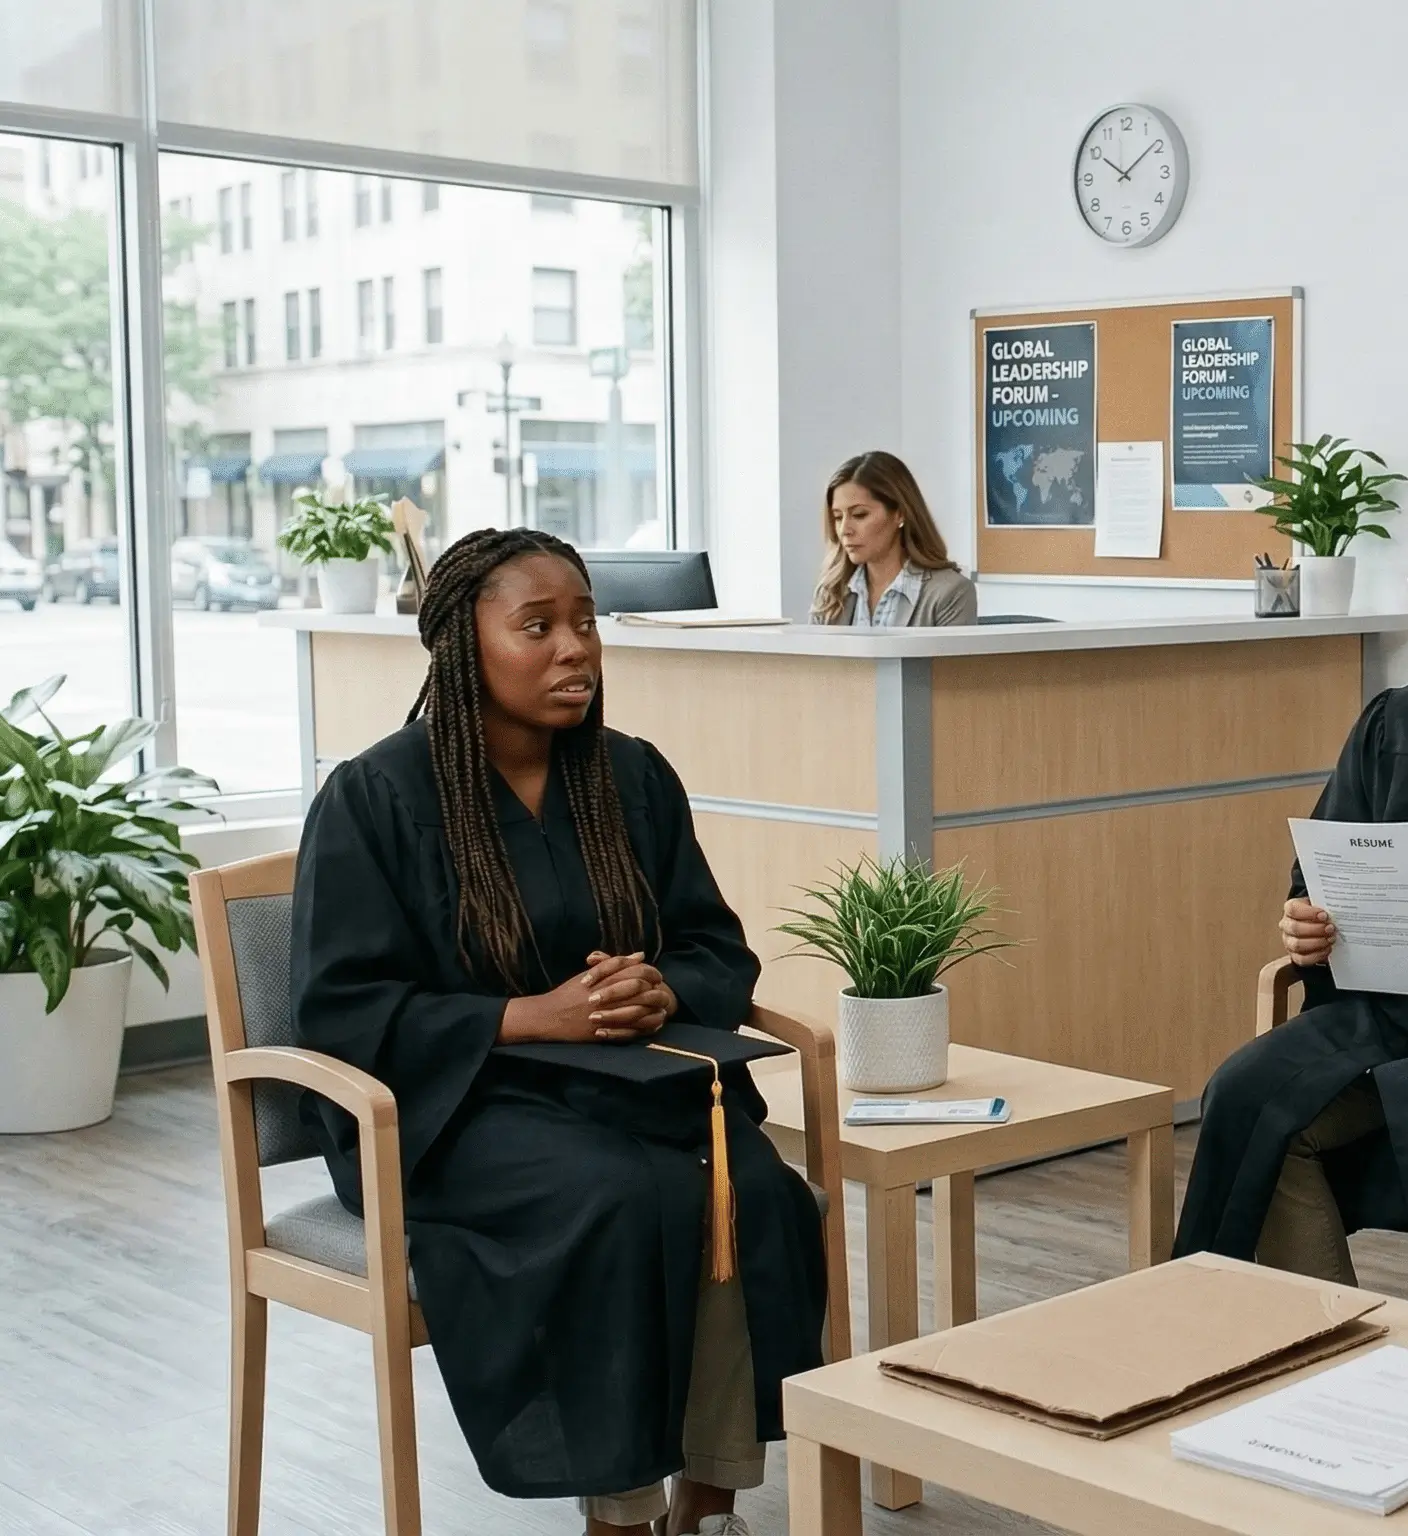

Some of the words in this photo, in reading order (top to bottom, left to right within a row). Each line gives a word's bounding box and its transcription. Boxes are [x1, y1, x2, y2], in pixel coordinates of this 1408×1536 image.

[1120, 116, 1133, 131] 12
[1102, 127, 1113, 141] 11
[1154, 138, 1165, 153] 2
[1159, 164, 1171, 179] 3
[1083, 172, 1094, 187] 9
[1090, 197, 1101, 212] 8
[1153, 191, 1165, 205] 4
[1104, 216, 1113, 231] 7
[1139, 211, 1150, 226] 5
[1121, 220, 1132, 235] 6
[991, 340, 1055, 360] GLOBAL
[1181, 337, 1233, 352] GLOBAL
[1182, 352, 1260, 368] LEADERSHIP
[992, 360, 1089, 383] LEADERSHIP
[1182, 369, 1227, 385] FORUM
[992, 385, 1048, 405] FORUM
[1182, 385, 1250, 400] UPCOMING
[992, 407, 1080, 428] UPCOMING
[1349, 838, 1395, 849] RESUME
